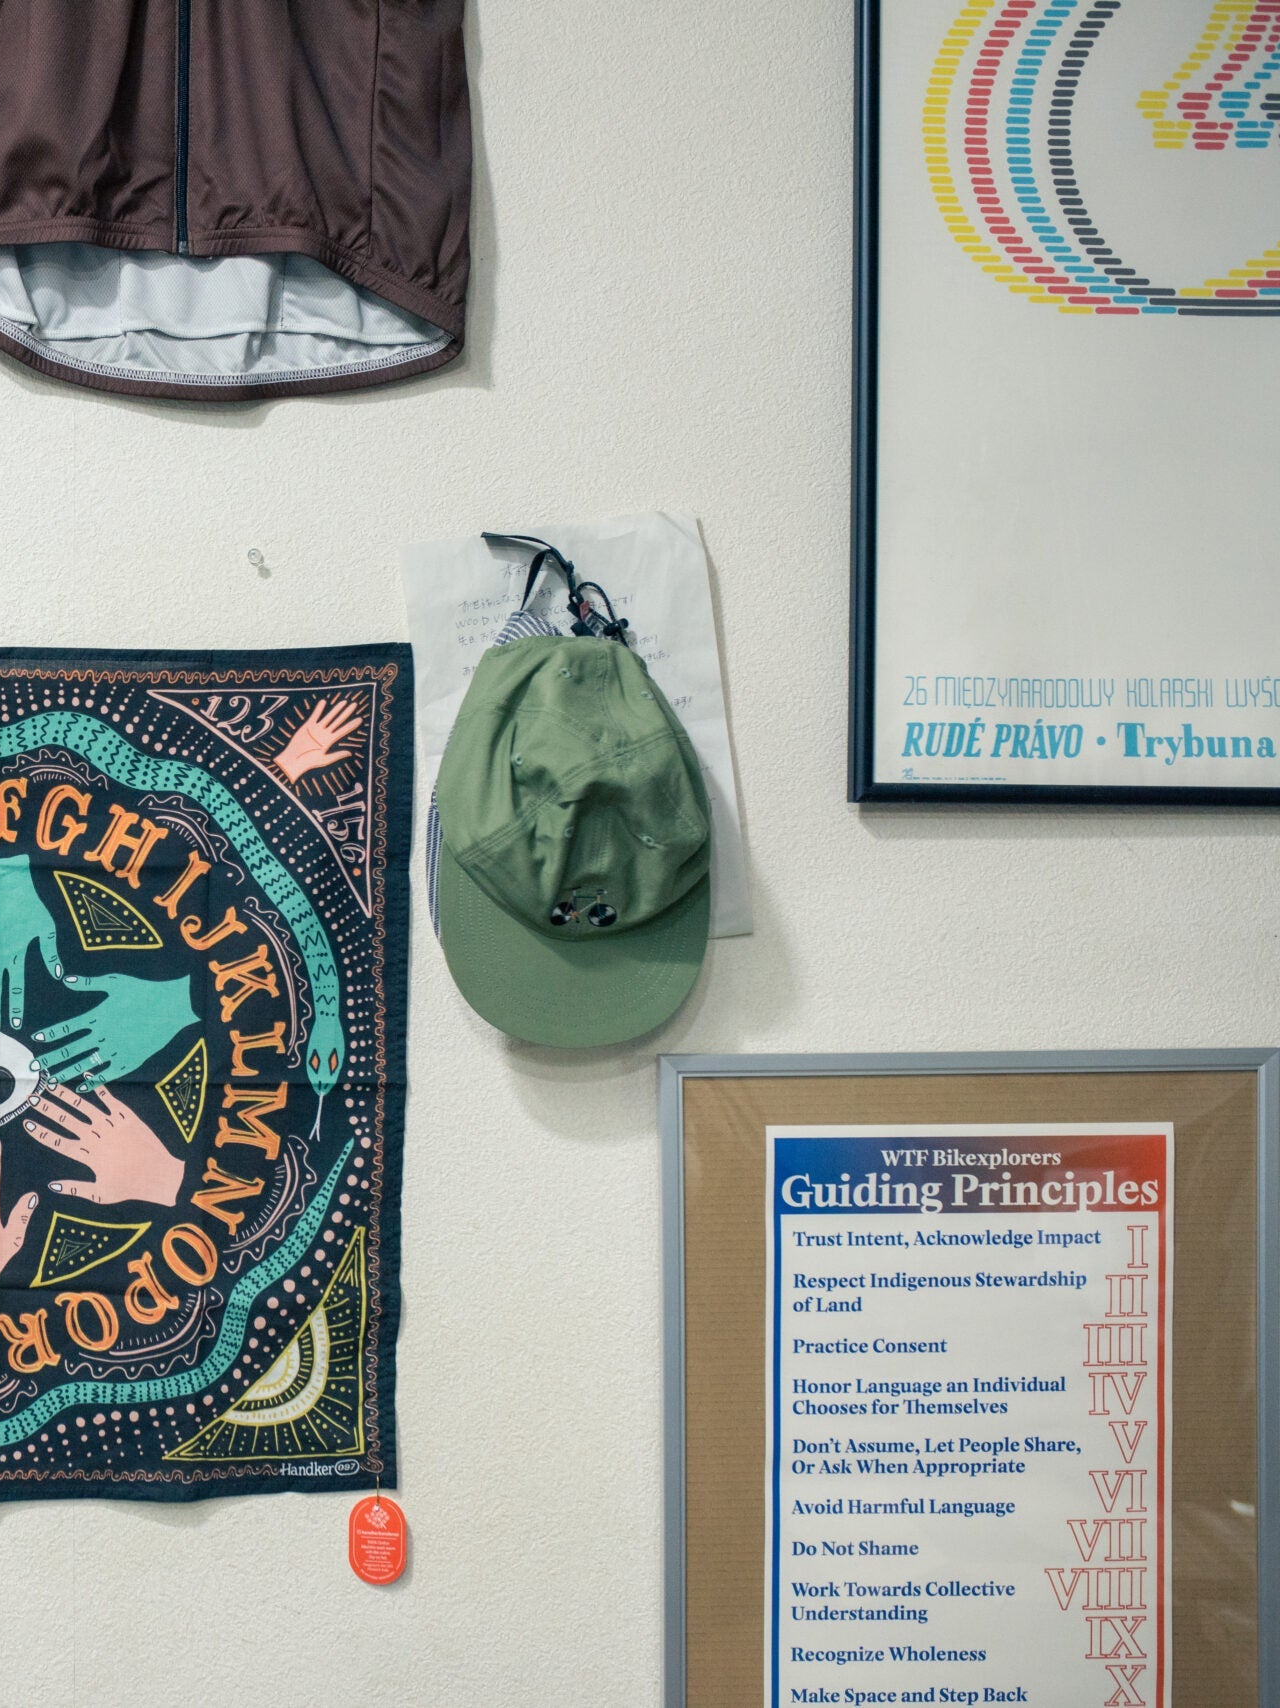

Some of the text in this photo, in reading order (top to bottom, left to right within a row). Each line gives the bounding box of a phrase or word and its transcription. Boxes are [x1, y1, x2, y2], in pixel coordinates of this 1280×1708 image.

[903, 675, 928, 706] 26
[935, 675, 1115, 709] MIĘDZYNARODOWY
[1126, 677, 1214, 708] KOLARSKI
[199, 695, 289, 742] 123
[901, 716, 1278, 766] RUDÉ PRÁVO Trybuna
[880, 1148, 1062, 1169] WTF Bikexplorers
[781, 1170, 1160, 1214] Guiding Principles
[792, 1229, 1102, 1249] Trust Intent, Acknowledge Impact
[1127, 1225, 1149, 1268] I
[793, 1270, 1088, 1292] Respect Indigenous Stewardship
[792, 1296, 863, 1313] of Land
[1105, 1274, 1149, 1317] II
[792, 1337, 948, 1354] Practice Consent
[1083, 1323, 1148, 1366] III
[793, 1375, 1067, 1398] Honor Language an Individual
[1088, 1372, 1148, 1415] IV
[792, 1398, 1009, 1416] Chooses for Themselves
[845, 1438, 921, 1456] Assume,
[924, 1438, 955, 1454] Let
[958, 1436, 1021, 1457] People
[1023, 1436, 1082, 1455] Share,
[1108, 1421, 1148, 1464] V
[791, 1457, 1026, 1478] Or Ask When Appropriate
[1088, 1470, 1148, 1513] VI
[791, 1497, 1016, 1518] Avoid Harmful Language
[791, 1539, 919, 1557] Do Not Shame
[1066, 1519, 1148, 1562] VII
[791, 1580, 1016, 1598] Work Towards Collective
[1044, 1567, 1148, 1611] VIII
[791, 1604, 929, 1624] Understanding
[1085, 1616, 1148, 1660] IX
[791, 1645, 987, 1666] Recognize Wholeness
[790, 1686, 1028, 1707] Make Space and Step Back
[1104, 1665, 1147, 1707] X
